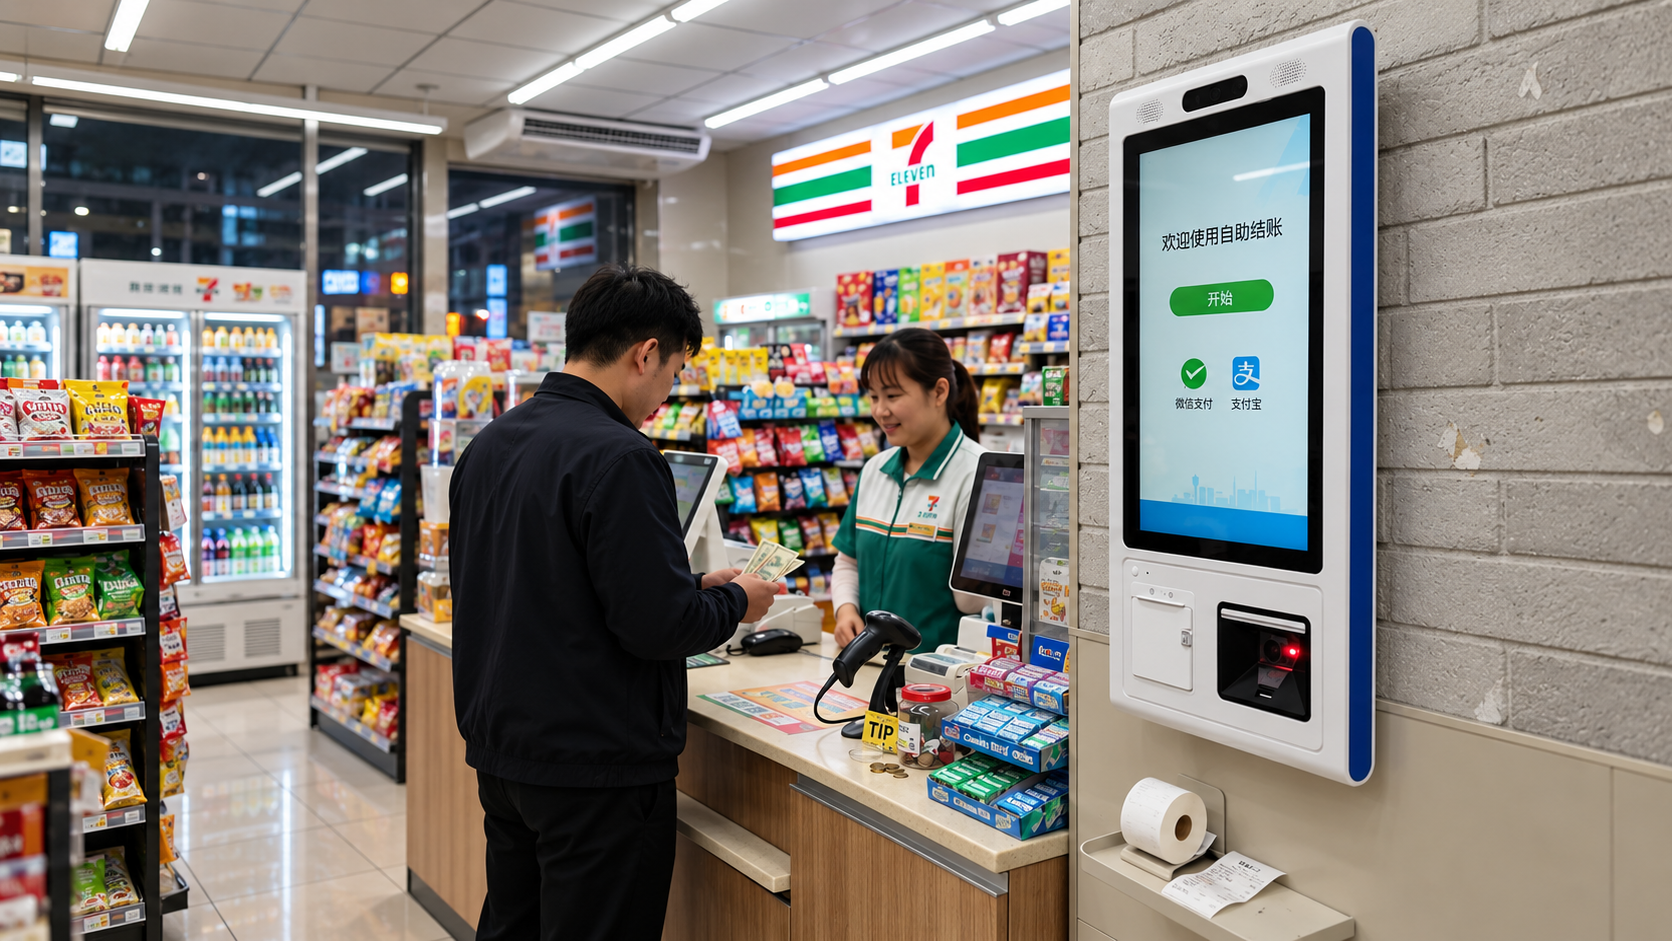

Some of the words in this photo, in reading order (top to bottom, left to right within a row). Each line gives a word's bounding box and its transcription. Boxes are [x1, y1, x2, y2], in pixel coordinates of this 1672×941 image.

[892, 121, 934, 207] 7
[1162, 217, 1283, 251] 欢迎使用自助结账
[1207, 290, 1233, 307] 开始
[1175, 397, 1213, 410] 微信支付
[1231, 397, 1262, 410] 支付宝
[869, 720, 894, 740] TIP
